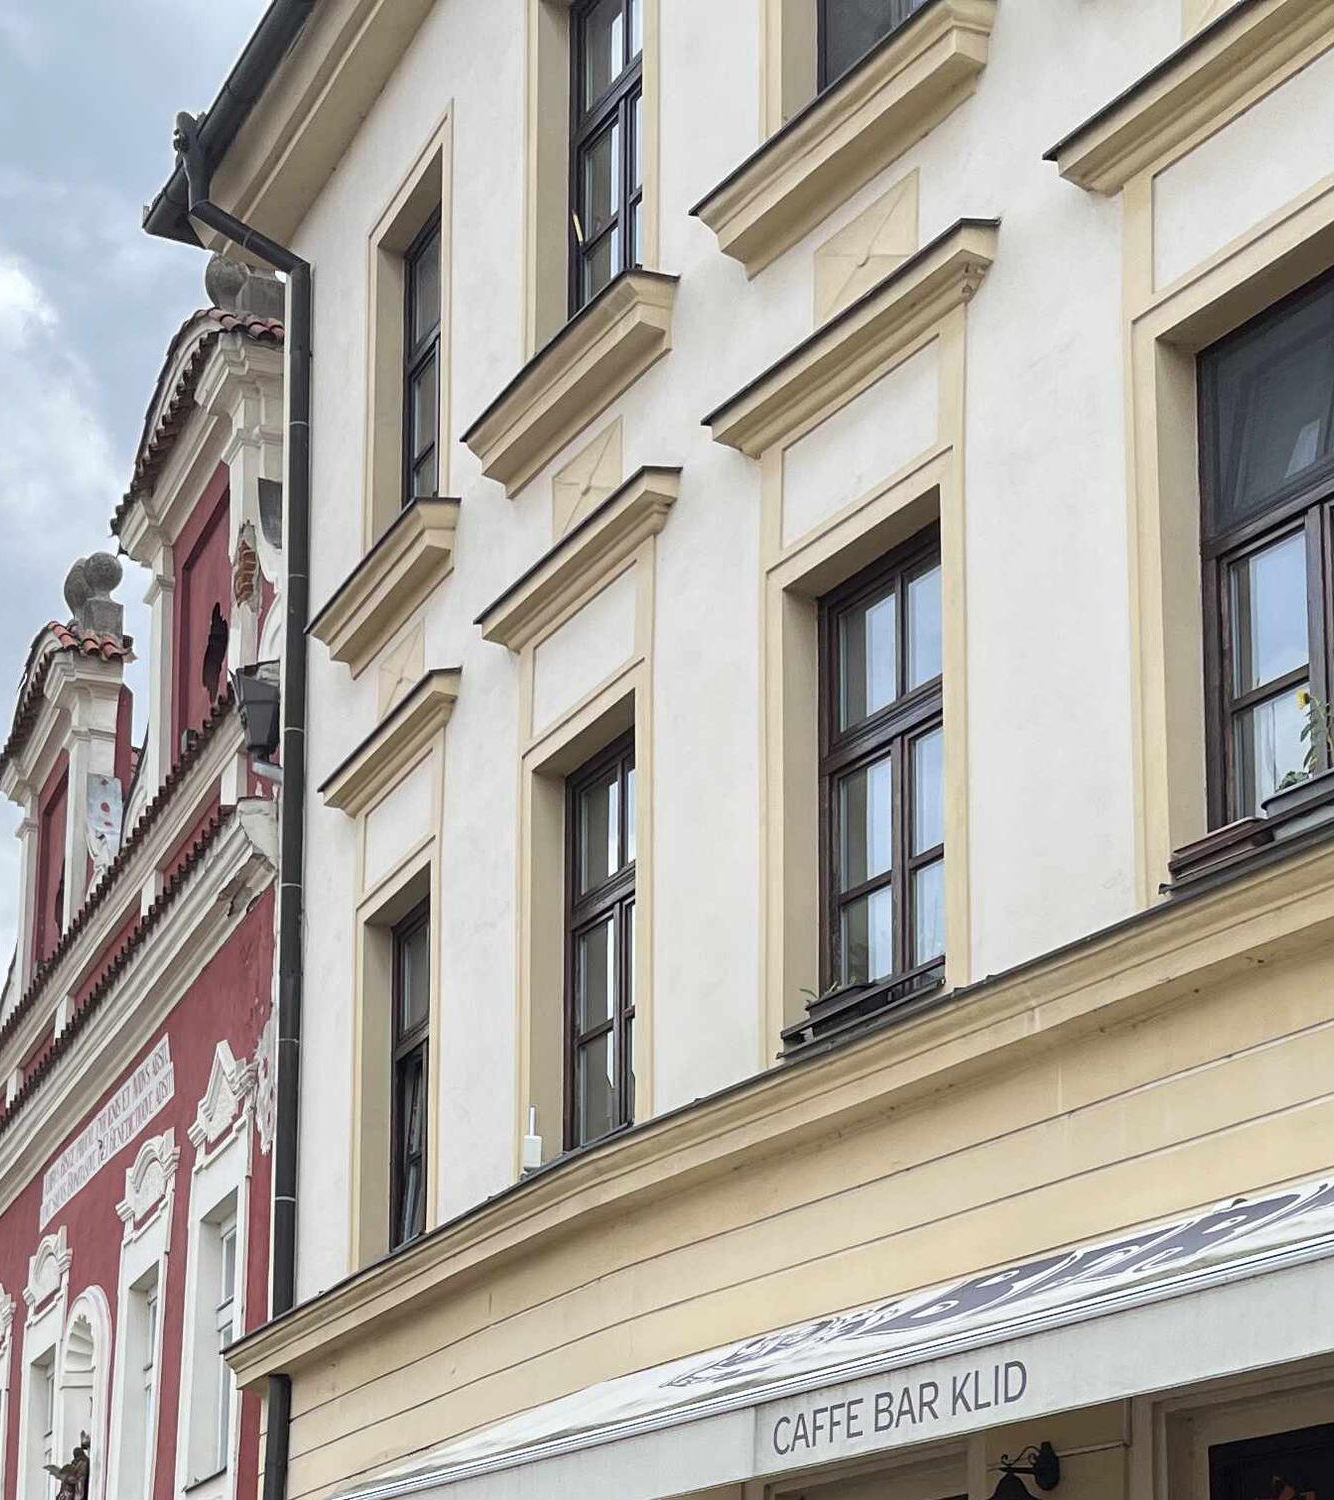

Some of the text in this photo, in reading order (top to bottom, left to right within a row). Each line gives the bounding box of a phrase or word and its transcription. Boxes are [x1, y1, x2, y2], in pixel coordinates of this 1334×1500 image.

[773, 1360, 1027, 1455] CAFFE BAR KLID
